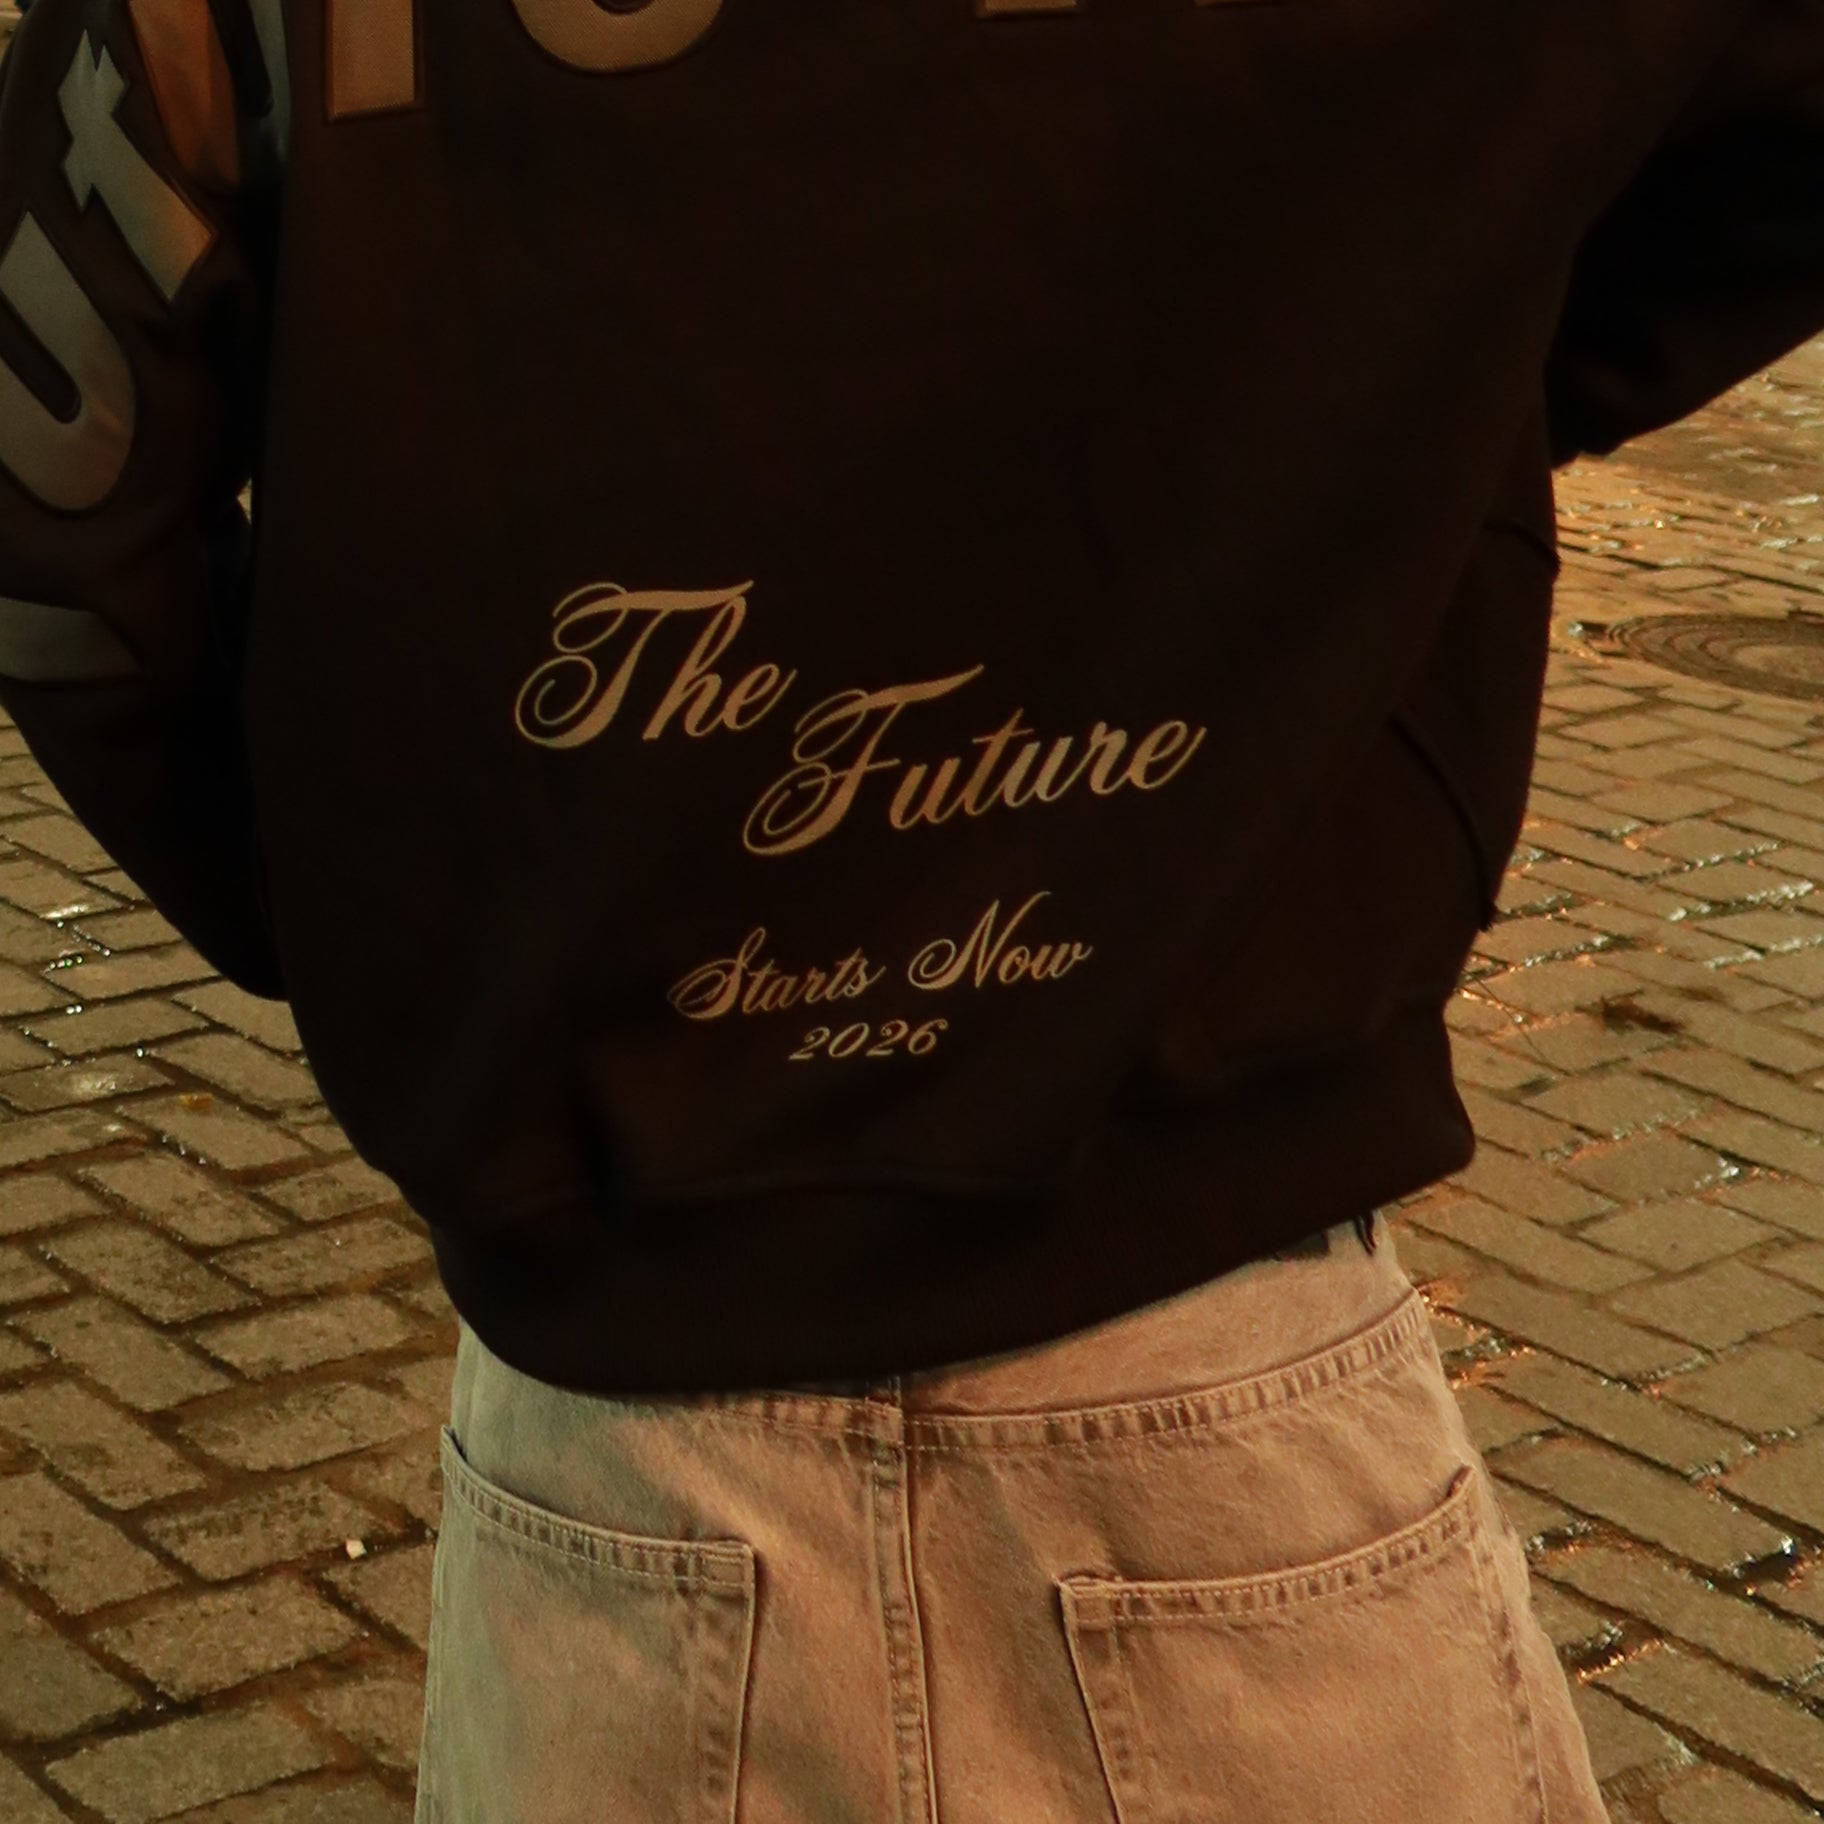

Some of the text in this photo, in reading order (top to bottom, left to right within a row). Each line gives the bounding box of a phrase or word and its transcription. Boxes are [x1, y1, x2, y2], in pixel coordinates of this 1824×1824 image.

[513, 578, 1207, 857] The Future
[665, 890, 1092, 1021] Starts Now
[788, 1017, 949, 1061] 2026
